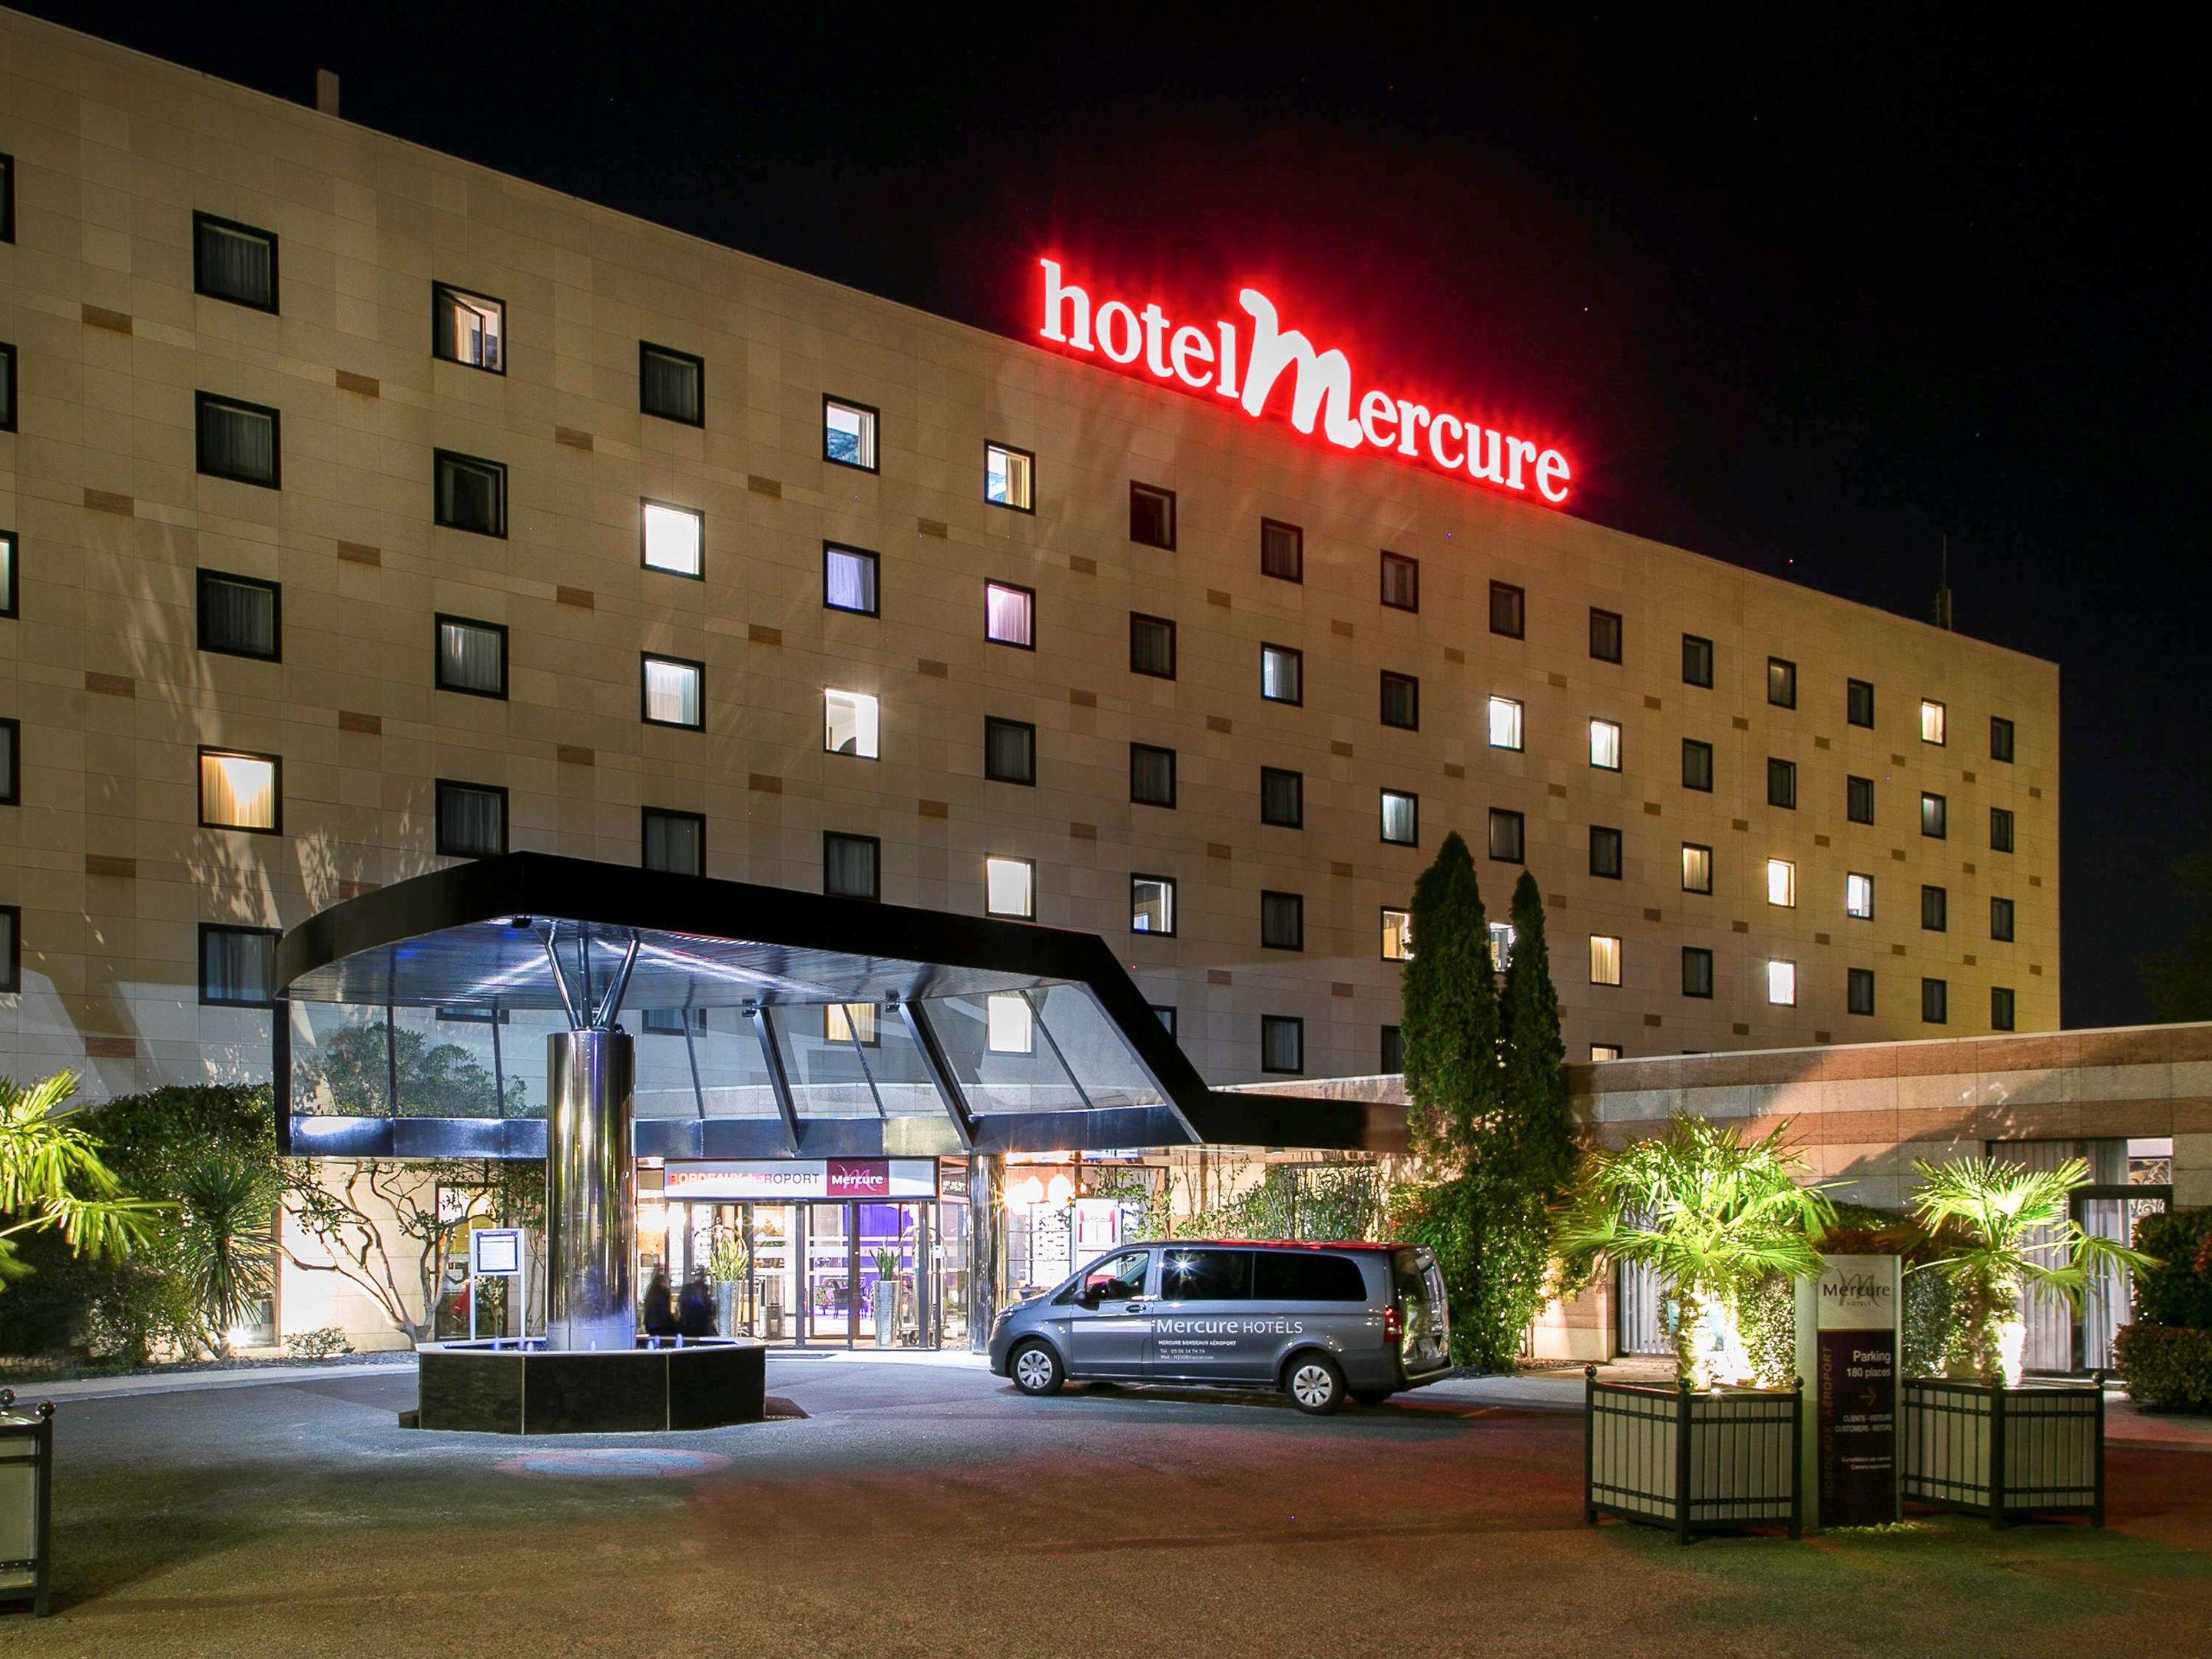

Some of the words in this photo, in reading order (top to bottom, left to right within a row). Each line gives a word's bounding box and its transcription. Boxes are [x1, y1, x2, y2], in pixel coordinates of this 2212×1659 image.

[1040, 258, 1240, 399] hotel
[831, 1175, 883, 1184] Mercure
[1823, 1283, 1891, 1296] Mercure
[1157, 1319, 1238, 1333] Mercure
[1243, 1321, 1303, 1333] HOTELS
[1853, 1350, 1891, 1364] Parking
[1846, 1367, 1863, 1377] 180
[1865, 1367, 1892, 1379] places
